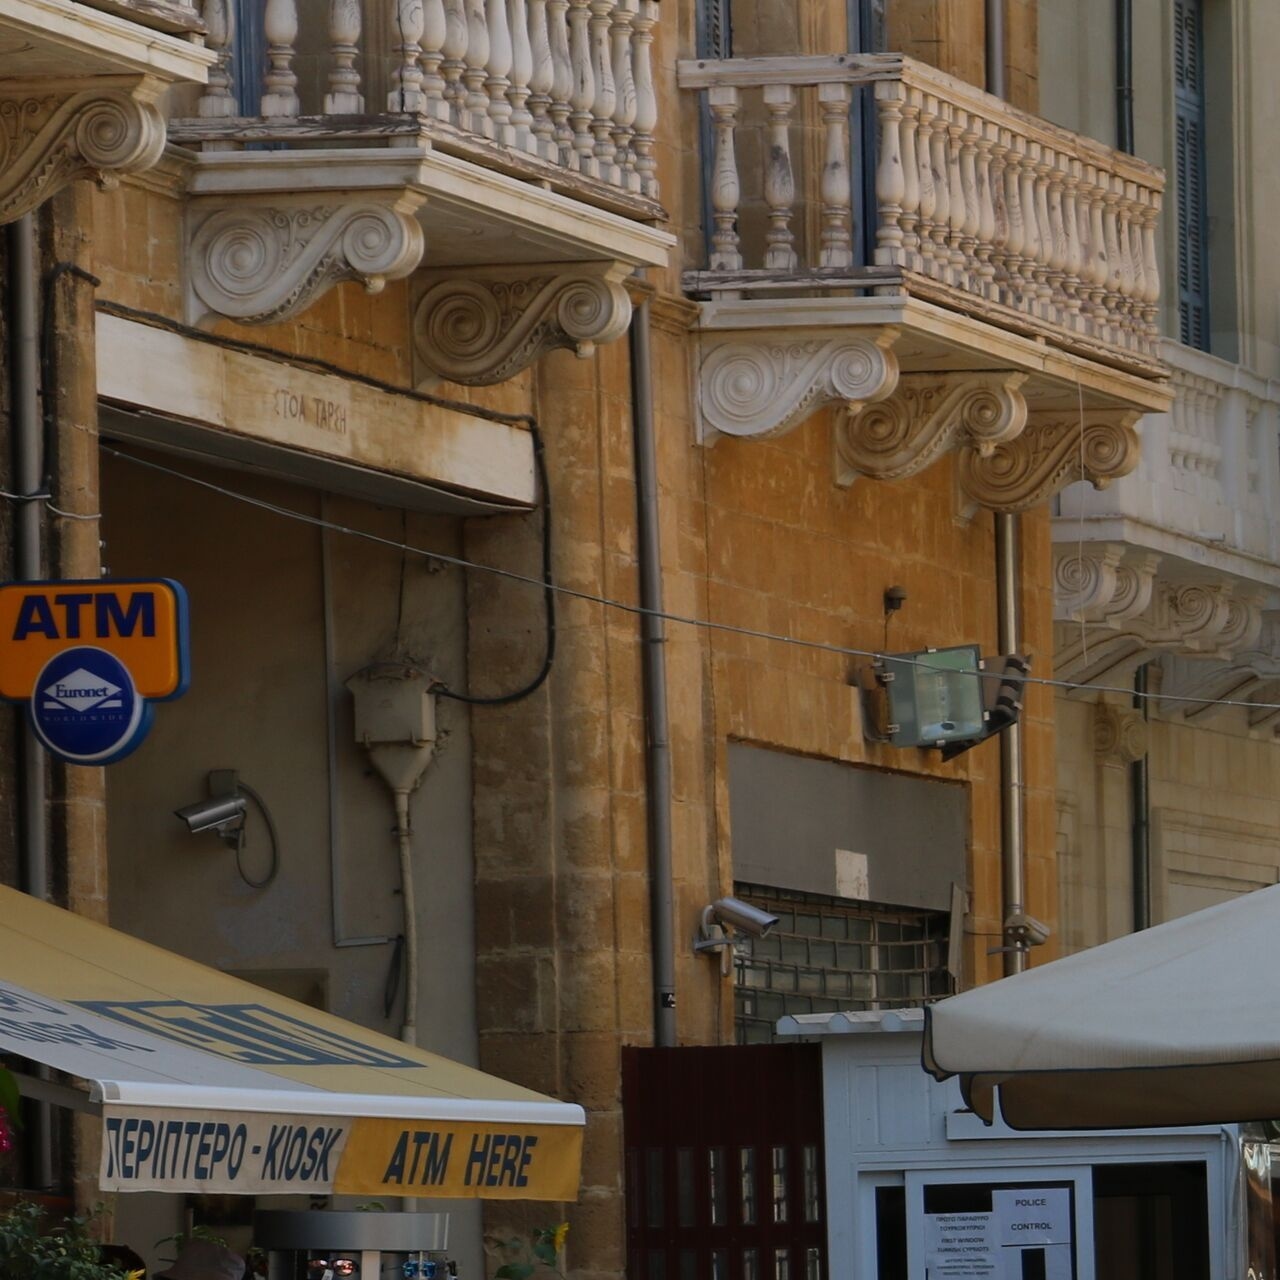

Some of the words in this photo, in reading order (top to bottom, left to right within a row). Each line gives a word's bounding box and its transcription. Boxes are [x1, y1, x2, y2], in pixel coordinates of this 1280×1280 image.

[12, 592, 156, 640] ATM
[55, 684, 109, 698] Euronet
[382, 1131, 454, 1186] ATM
[464, 1134, 538, 1188] HERE
[1015, 1198, 1047, 1208] POLICE
[1010, 1222, 1053, 1231] CONTROL
